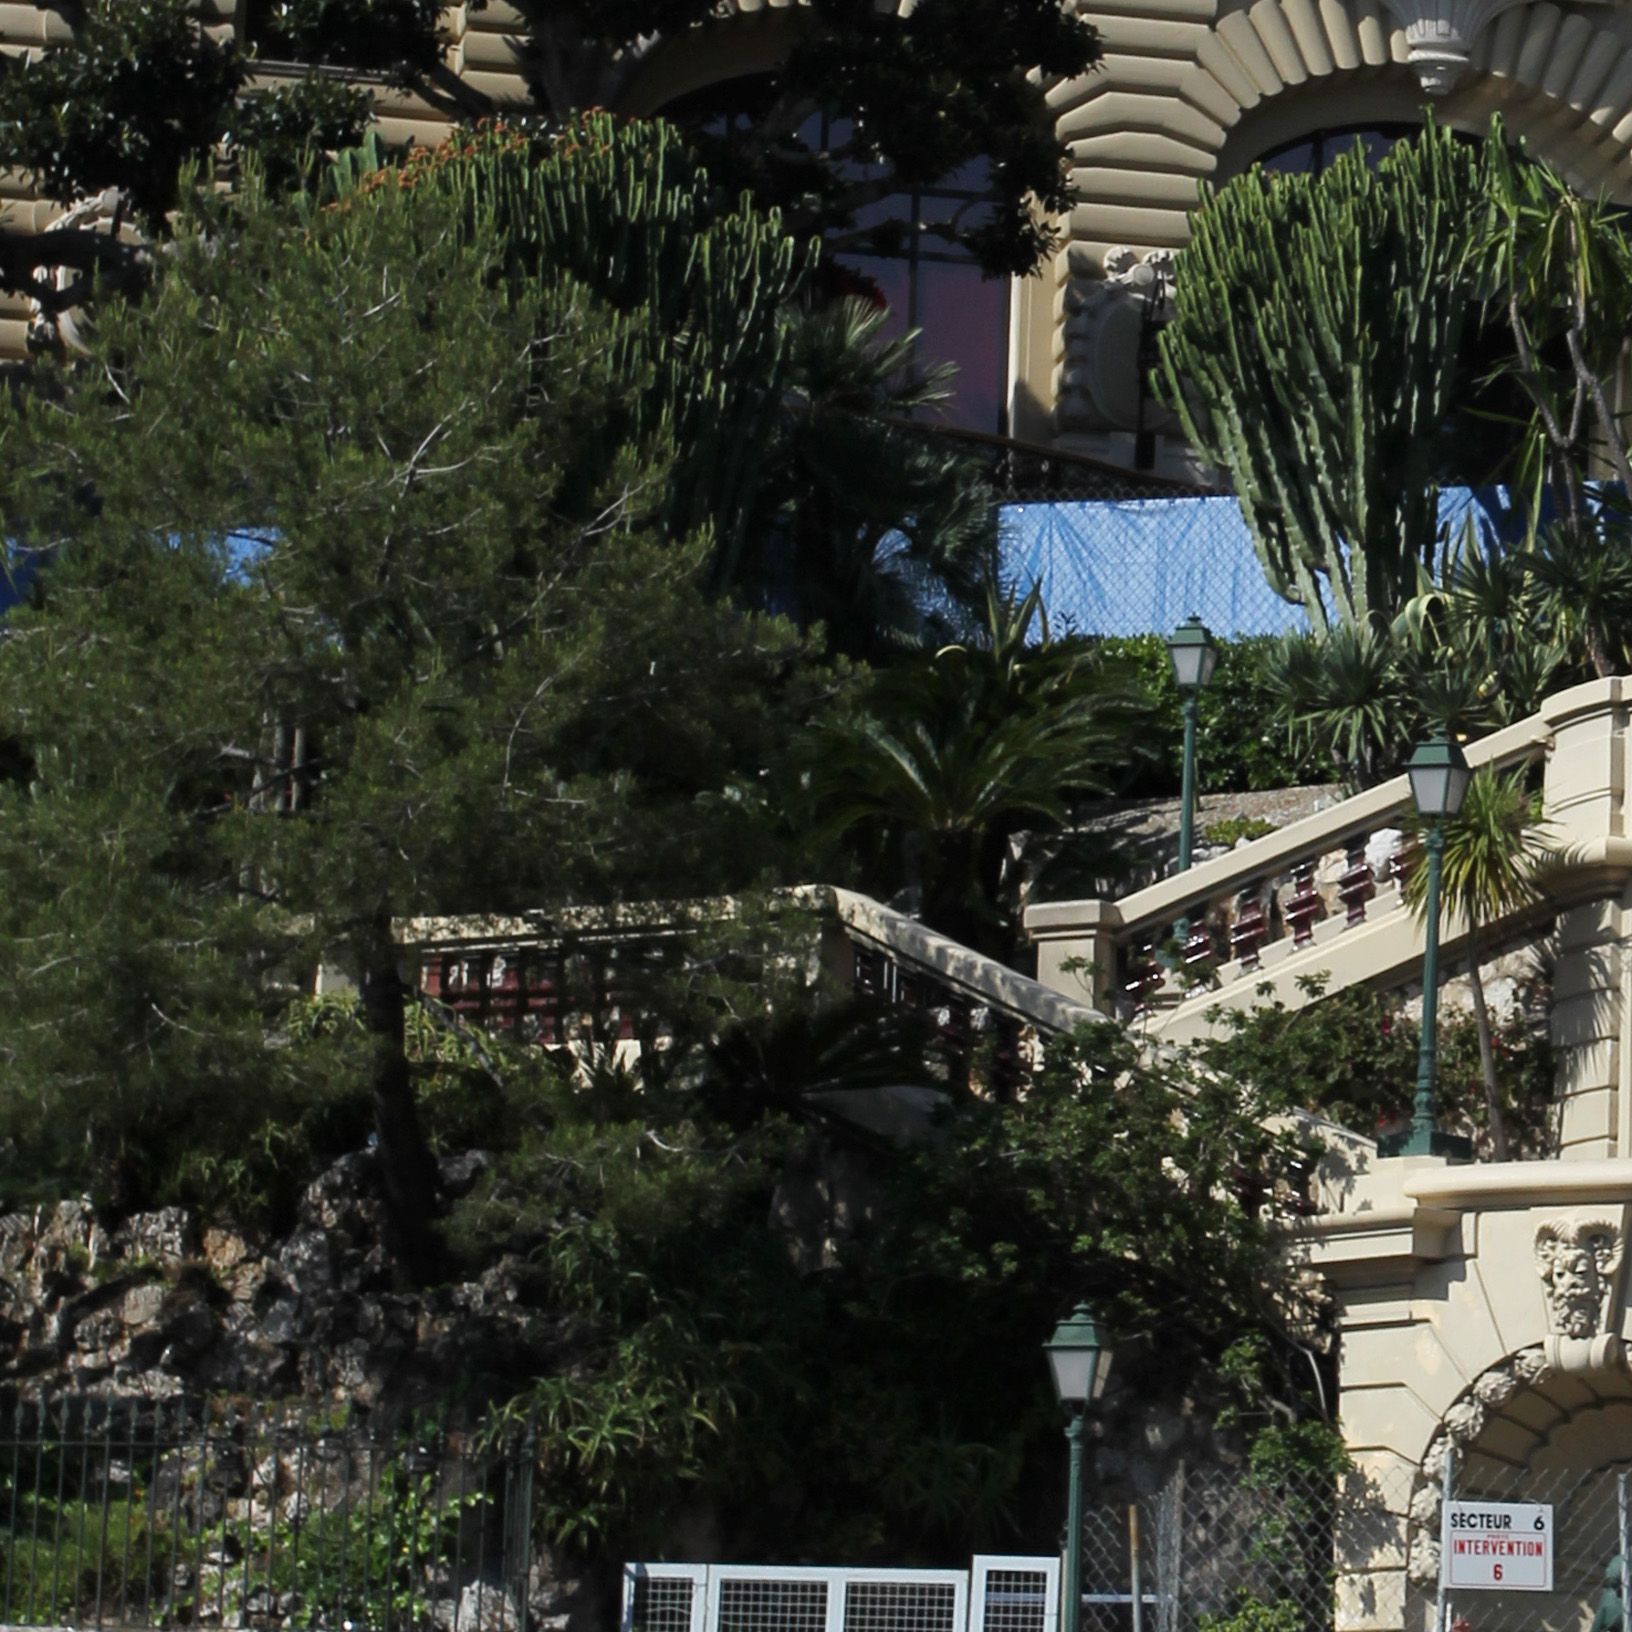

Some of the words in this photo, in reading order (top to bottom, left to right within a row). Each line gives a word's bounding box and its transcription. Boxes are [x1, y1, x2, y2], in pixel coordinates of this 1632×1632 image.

[1450, 1512, 1512, 1529] SECTEUR
[1533, 1515, 1545, 1531] 6
[1453, 1539, 1543, 1557] INTERVENTION
[1493, 1563, 1503, 1581] 6
